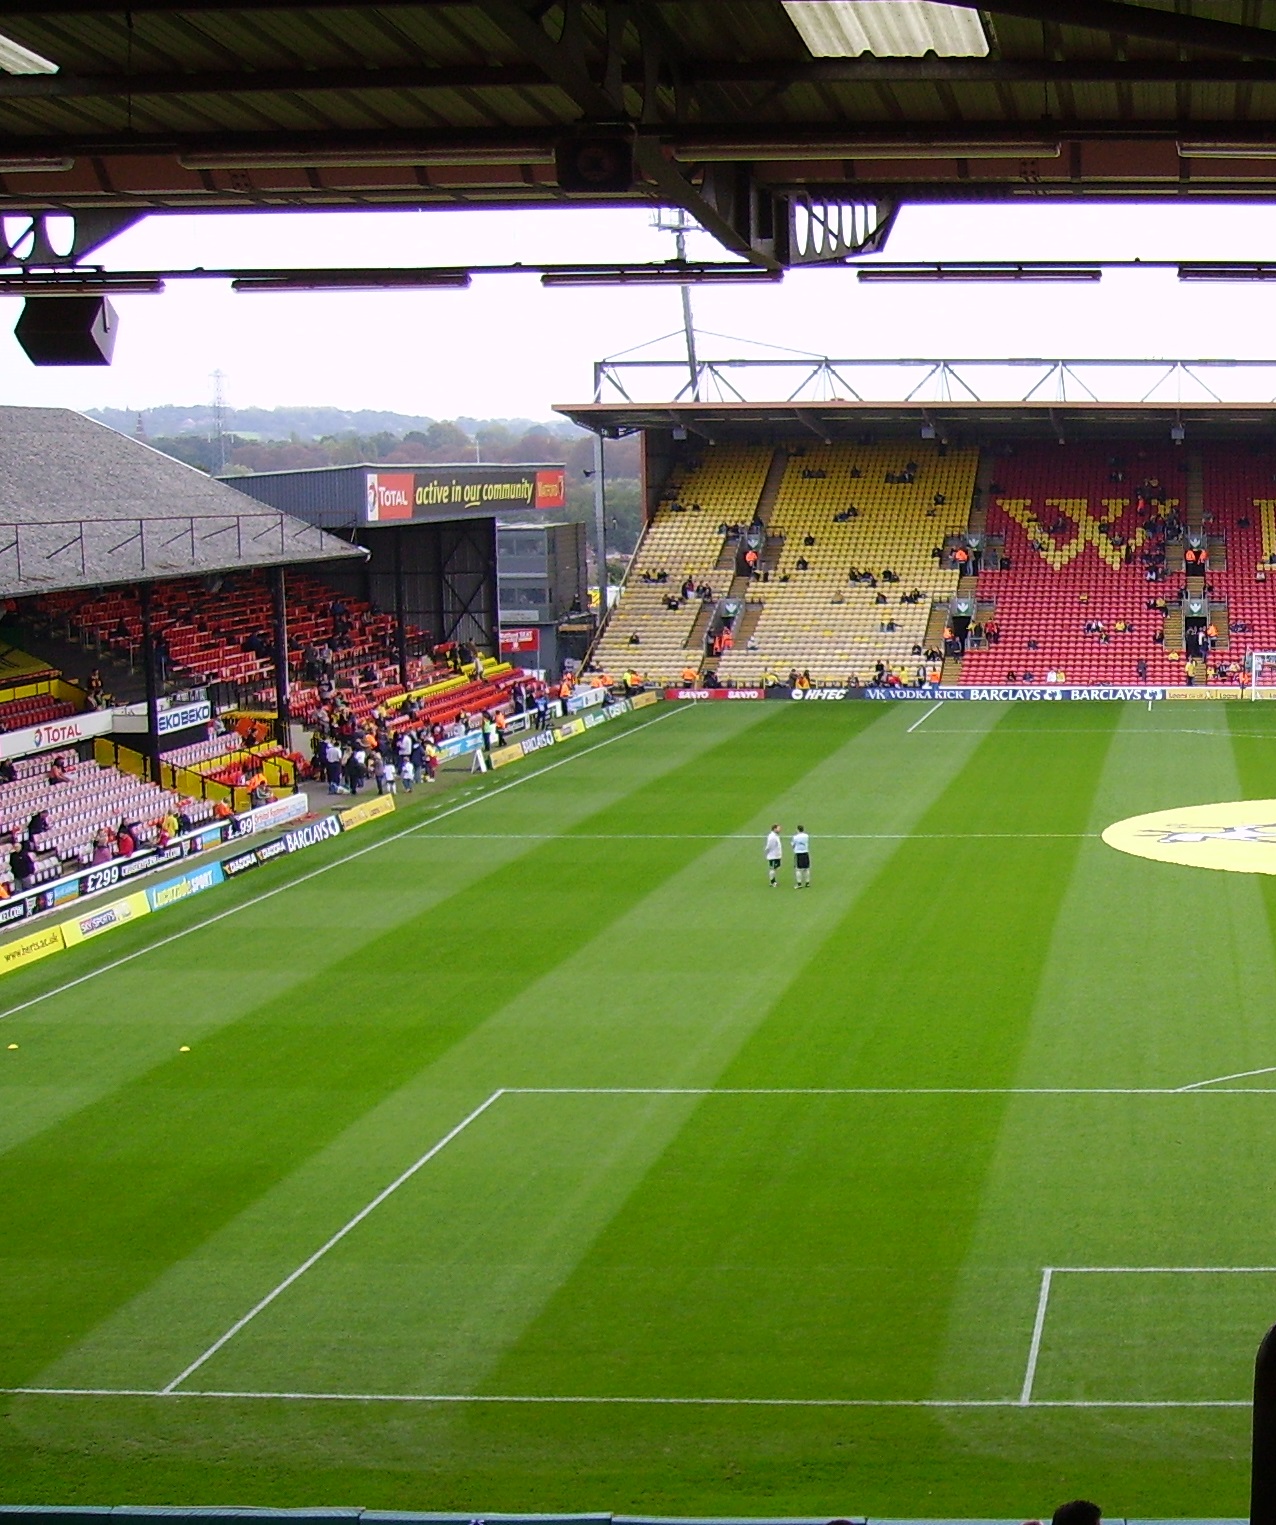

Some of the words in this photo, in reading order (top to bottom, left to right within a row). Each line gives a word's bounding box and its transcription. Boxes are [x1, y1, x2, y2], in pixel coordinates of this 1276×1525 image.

[379, 487, 408, 506] TOTAL
[416, 480, 449, 506] active
[451, 479, 461, 503] in
[464, 484, 482, 501] our
[482, 478, 534, 504] community
[678, 690, 710, 699] SANYO
[727, 690, 758, 699] SANYO
[804, 689, 847, 700] HI-TEC
[866, 689, 887, 699] VK
[889, 690, 932, 699] VODKA
[934, 690, 964, 699] KICK
[969, 689, 1041, 700] BARCLAYS
[1070, 689, 1142, 700] BARCLAYS
[159, 713, 180, 731] EKO
[180, 705, 210, 725] BEKO
[44, 724, 82, 744] TOTAL
[286, 821, 330, 852] BARCLAYS
[87, 866, 119, 893] £299
[190, 870, 213, 893] SPORT
